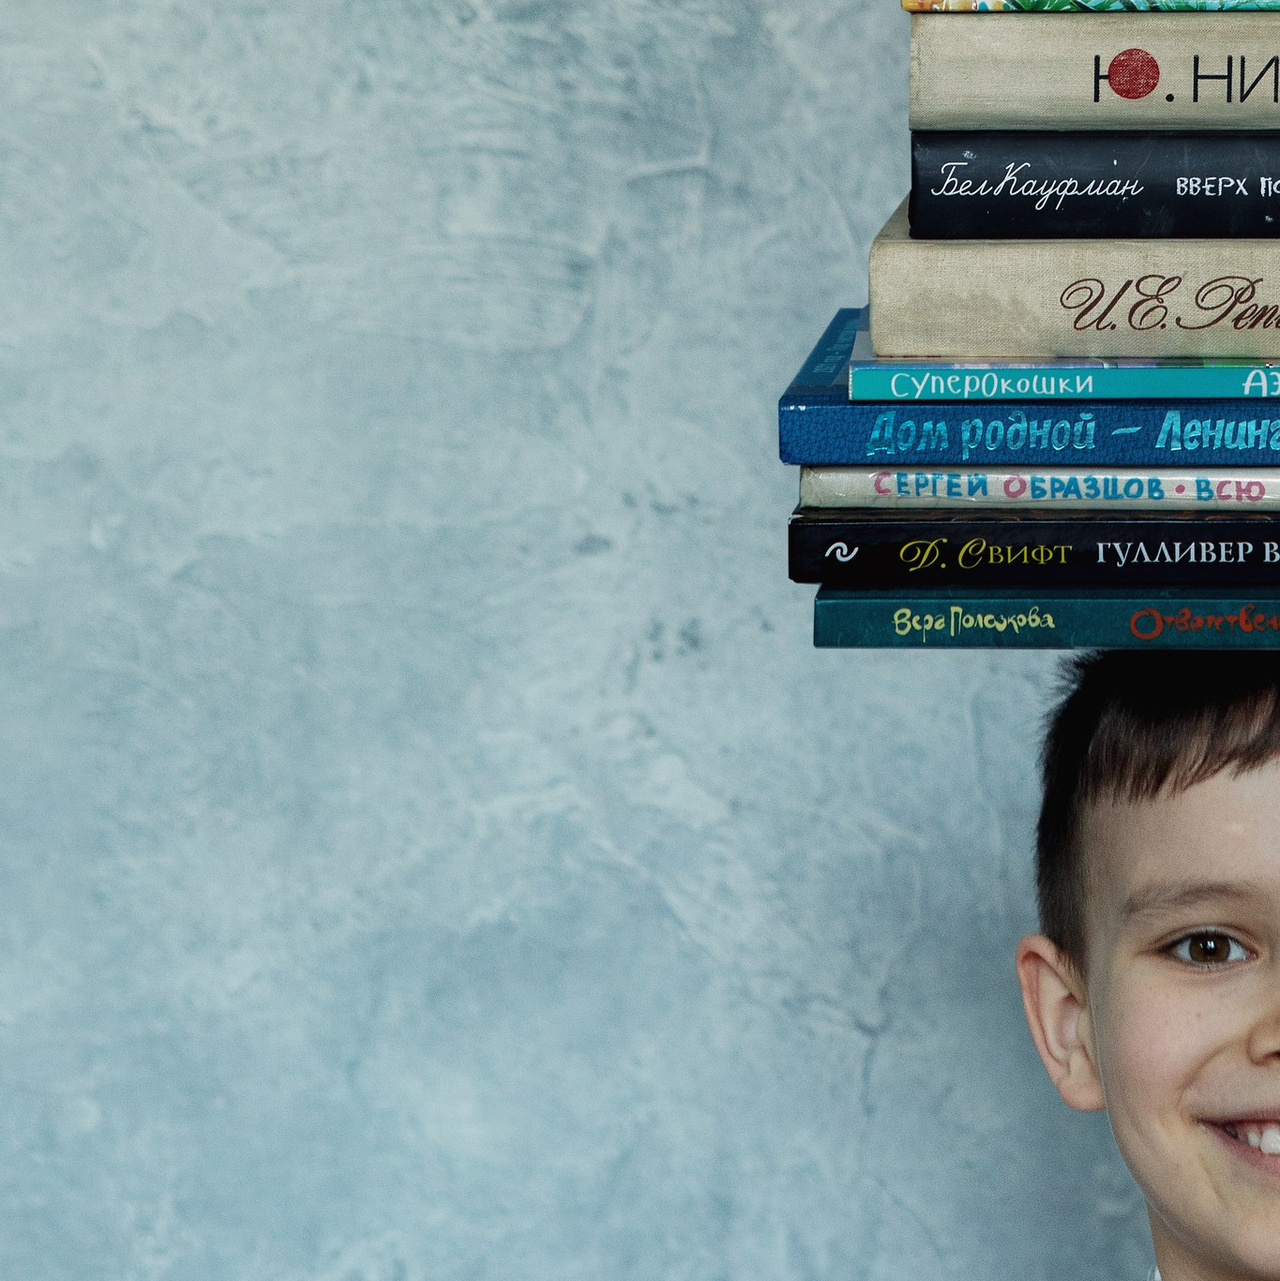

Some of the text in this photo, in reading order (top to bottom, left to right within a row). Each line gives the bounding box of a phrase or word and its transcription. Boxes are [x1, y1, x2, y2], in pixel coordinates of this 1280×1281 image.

[1094, 48, 1175, 104] Ю.
[931, 162, 1143, 210] Бел Кауфман
[1176, 177, 1248, 196] ВВЕРХ
[866, 410, 949, 457] Дом
[961, 410, 1096, 460] родной
[873, 471, 1166, 501] СЕРГЕЙ ОБРАЗЦОВ
[1196, 477, 1266, 502] ВСЮ
[900, 538, 946, 572] Д.
[1096, 541, 1255, 564] ГУЛЛИВЕР
[1264, 541, 1280, 563] В
[892, 607, 946, 644] Вера
